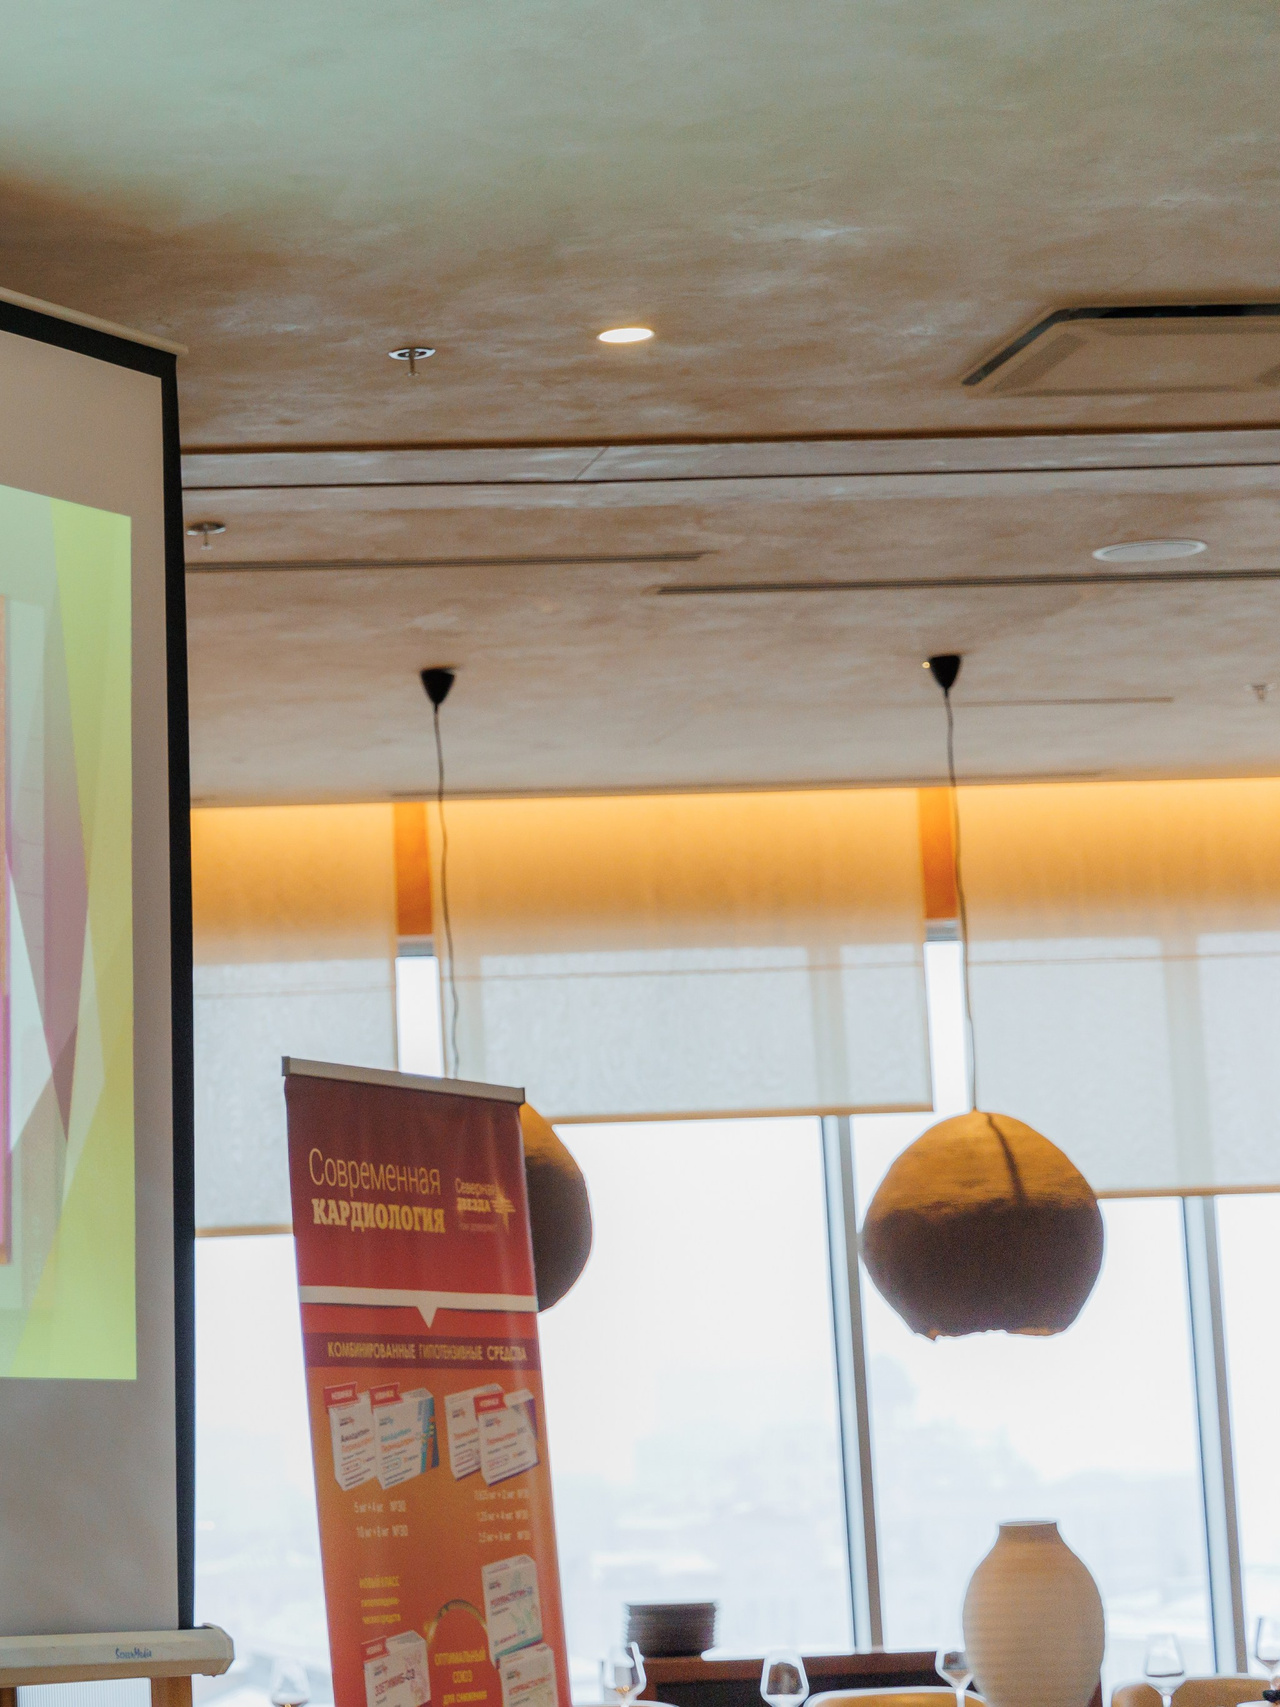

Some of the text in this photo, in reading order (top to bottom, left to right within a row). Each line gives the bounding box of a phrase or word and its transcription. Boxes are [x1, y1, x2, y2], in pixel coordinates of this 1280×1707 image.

[308, 1147, 442, 1196] Современная
[311, 1198, 446, 1233] КАРДИОЛОГИЯ
[327, 1341, 416, 1360] КОМБИНИРОВАННЫЕ
